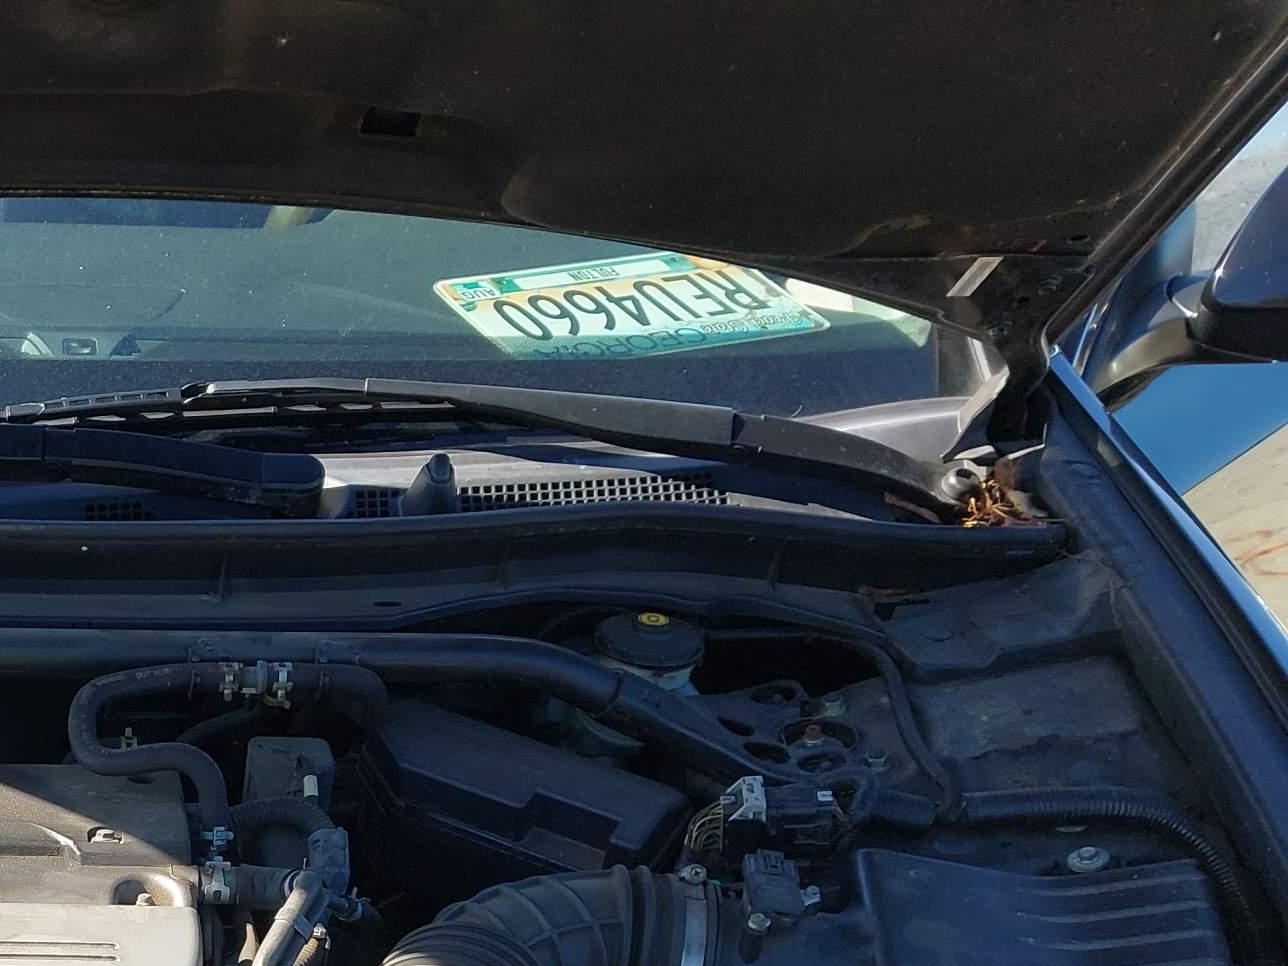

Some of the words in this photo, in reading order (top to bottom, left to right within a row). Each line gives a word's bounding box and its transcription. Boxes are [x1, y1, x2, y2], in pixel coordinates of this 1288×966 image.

[568, 267, 620, 281] FULTON
[462, 288, 497, 299] AUG
[493, 270, 772, 341] REU4660
